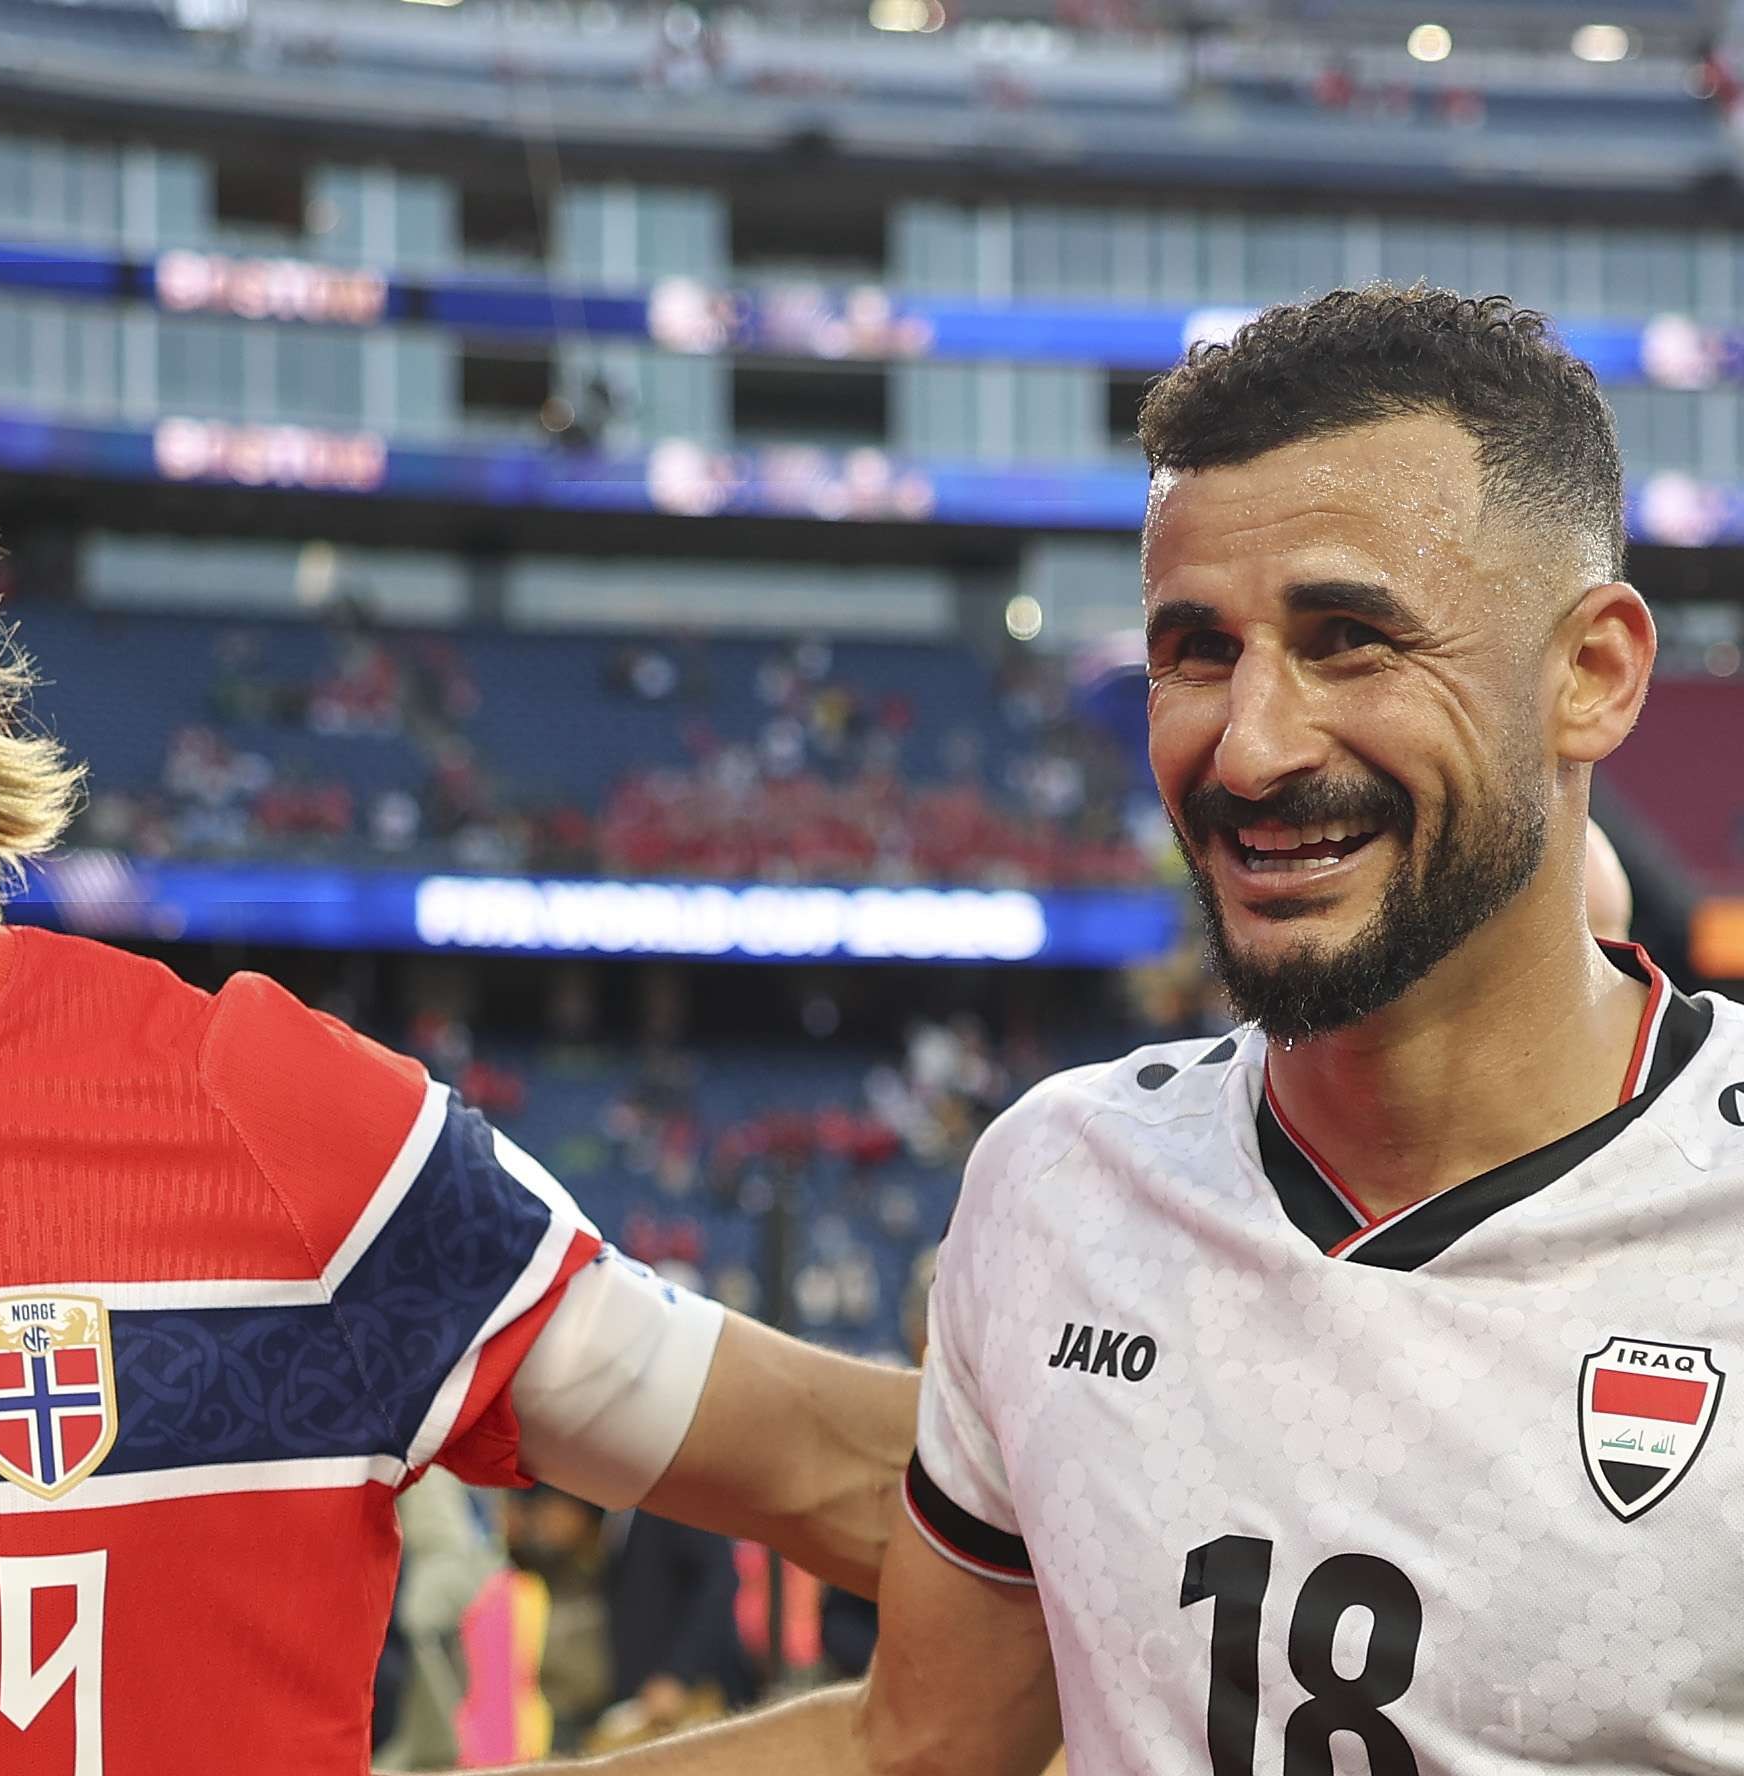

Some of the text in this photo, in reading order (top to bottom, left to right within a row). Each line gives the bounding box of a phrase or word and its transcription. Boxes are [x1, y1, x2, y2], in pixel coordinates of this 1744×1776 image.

[11, 1302, 57, 1323] NORGE
[1048, 1322, 1157, 1383] JAKO
[1617, 1348, 1696, 1374] IRAQ
